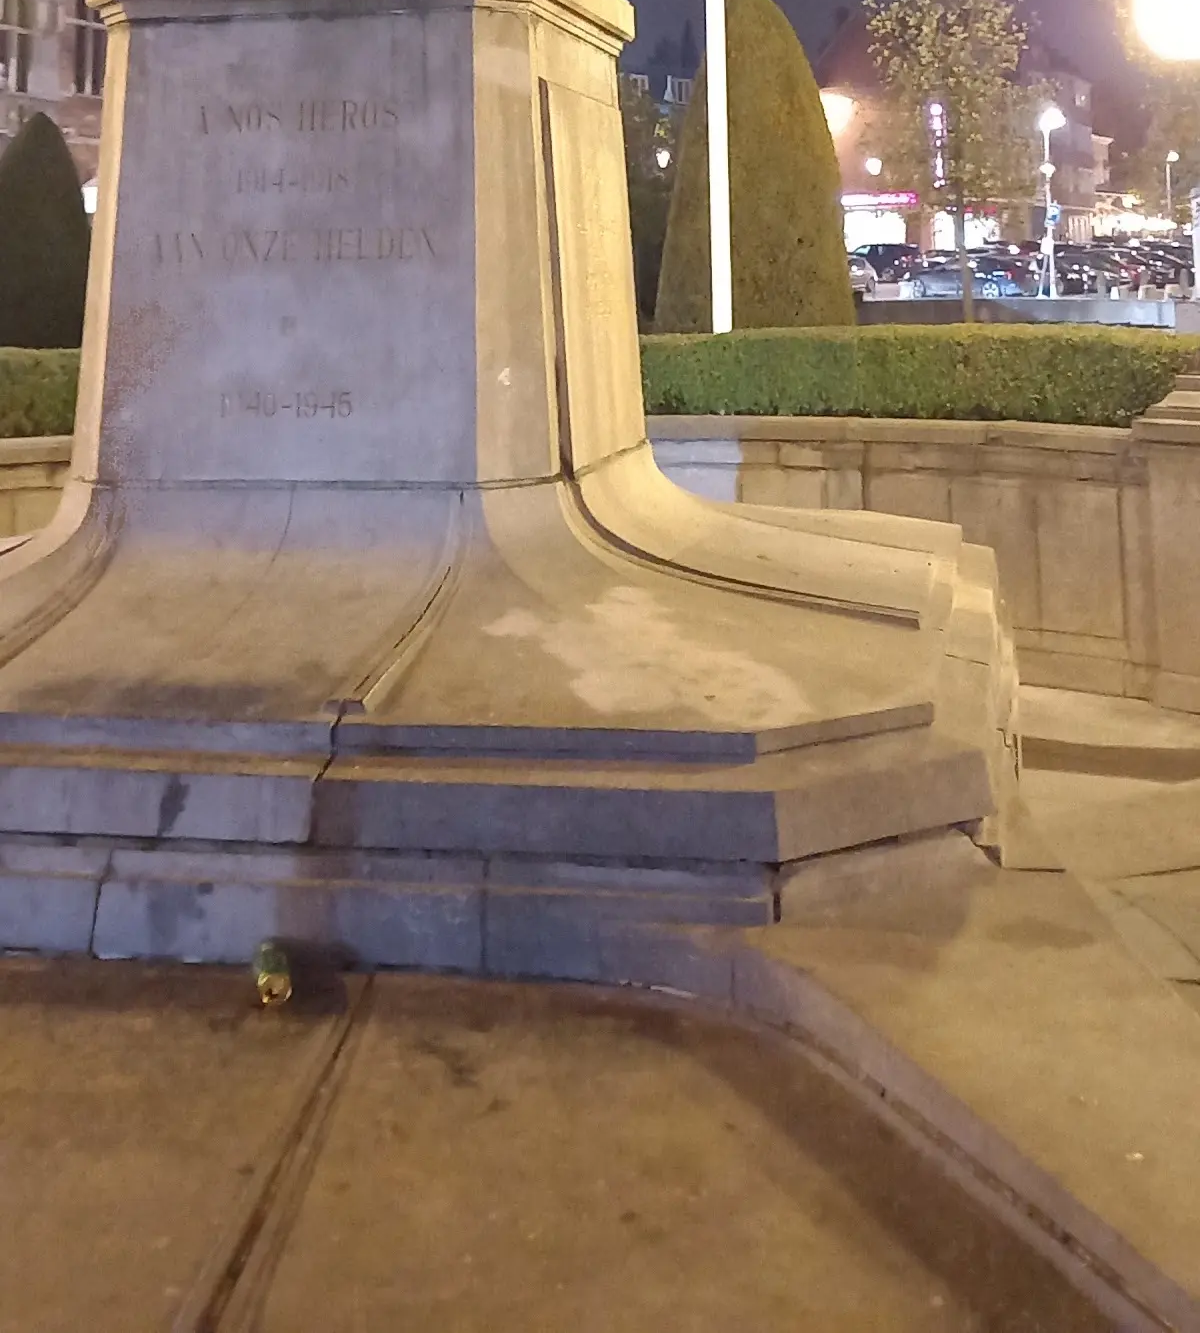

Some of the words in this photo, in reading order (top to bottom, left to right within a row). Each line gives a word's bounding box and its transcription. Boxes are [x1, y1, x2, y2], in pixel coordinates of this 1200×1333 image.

[227, 101, 282, 133] NOS
[221, 229, 298, 263] ONZE
[312, 226, 438, 262] HELDEN
[219, 390, 353, 419] 140-1945
